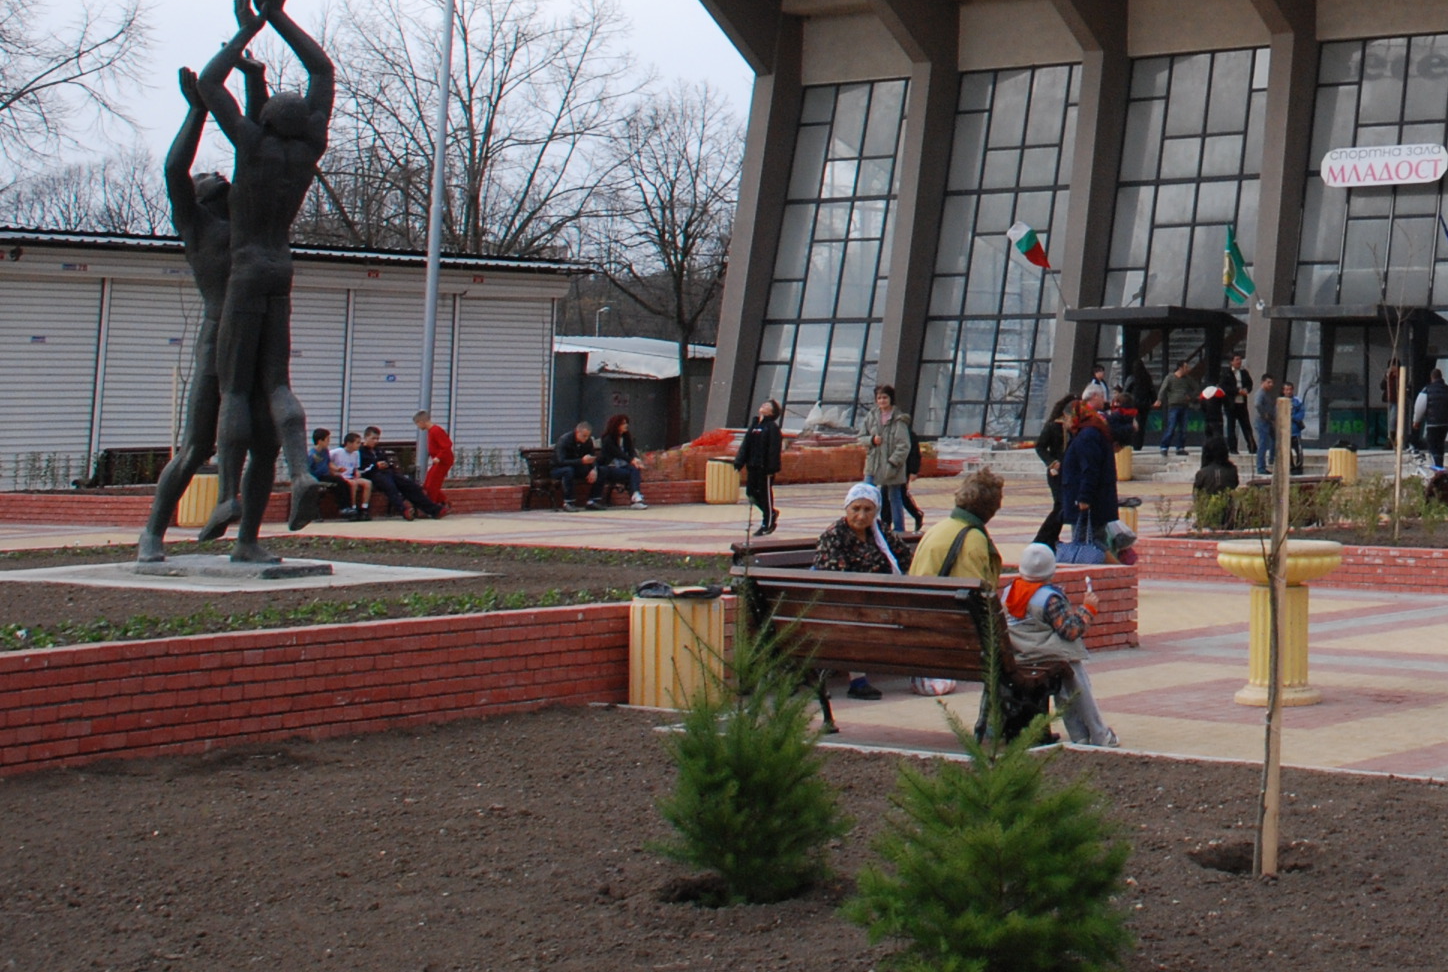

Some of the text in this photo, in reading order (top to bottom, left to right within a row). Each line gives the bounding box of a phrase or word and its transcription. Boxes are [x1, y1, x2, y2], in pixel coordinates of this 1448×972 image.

[1330, 144, 1441, 161] спортна зала
[1327, 159, 1442, 183] МЛАДОСТ
